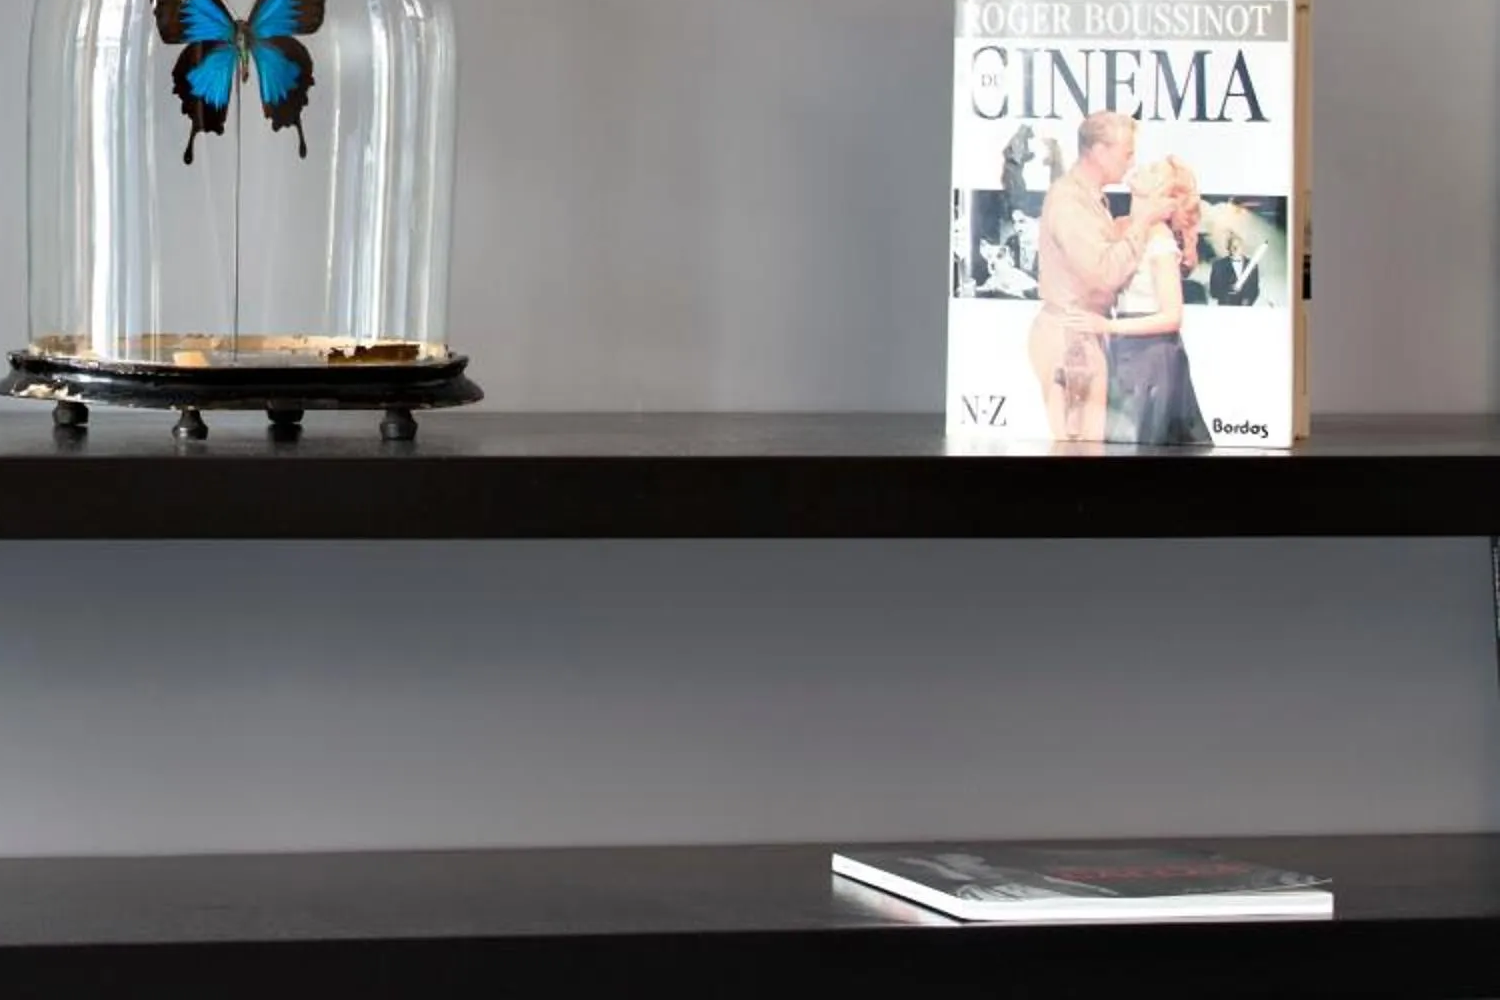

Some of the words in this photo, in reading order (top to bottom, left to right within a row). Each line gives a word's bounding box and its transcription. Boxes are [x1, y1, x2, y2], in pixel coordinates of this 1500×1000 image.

[961, 1, 1071, 35] ROGER
[1085, 2, 1271, 36] BOUSSINOT
[971, 45, 1270, 122] CINEMA
[961, 395, 1007, 427] N-Z
[1213, 418, 1269, 439] Bordas
